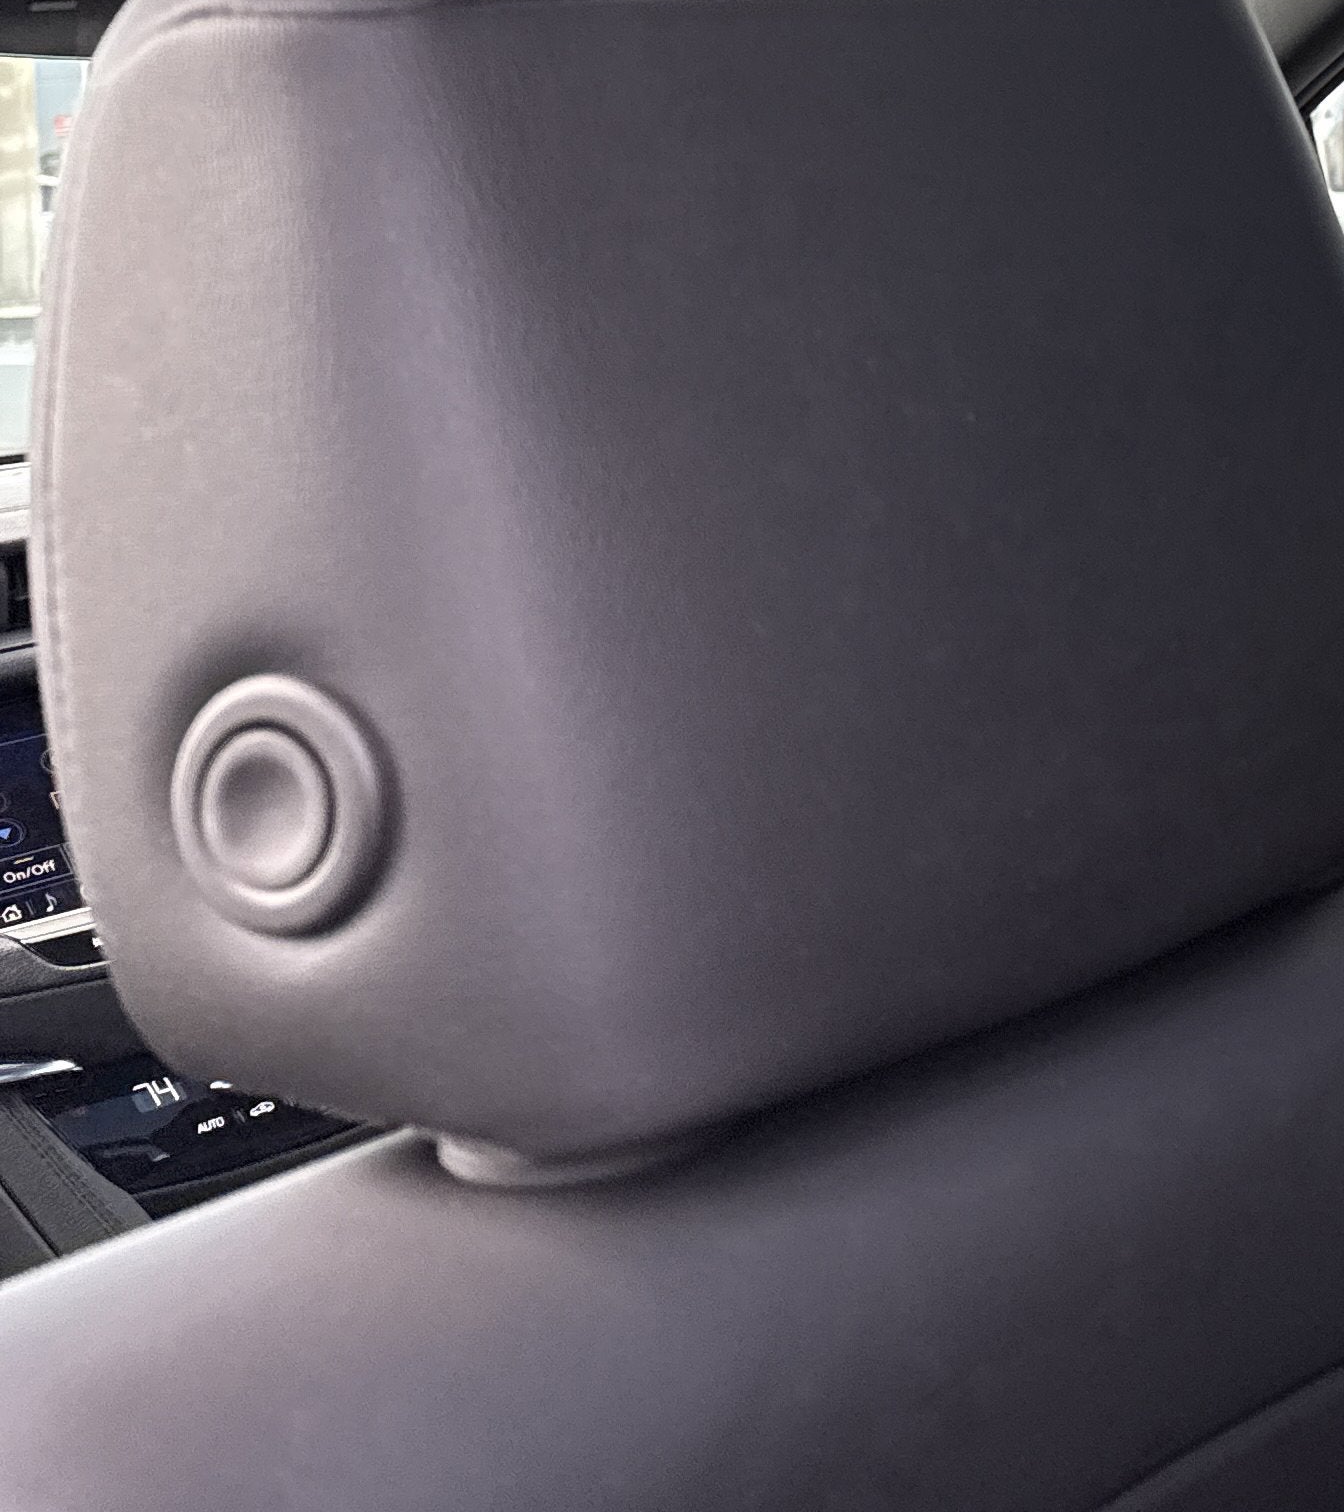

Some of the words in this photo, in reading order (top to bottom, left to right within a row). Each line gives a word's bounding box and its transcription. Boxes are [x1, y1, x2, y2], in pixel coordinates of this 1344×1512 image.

[3, 859, 56, 884] On/Off
[132, 1077, 181, 1107] 74
[197, 1115, 226, 1134] AUTO
